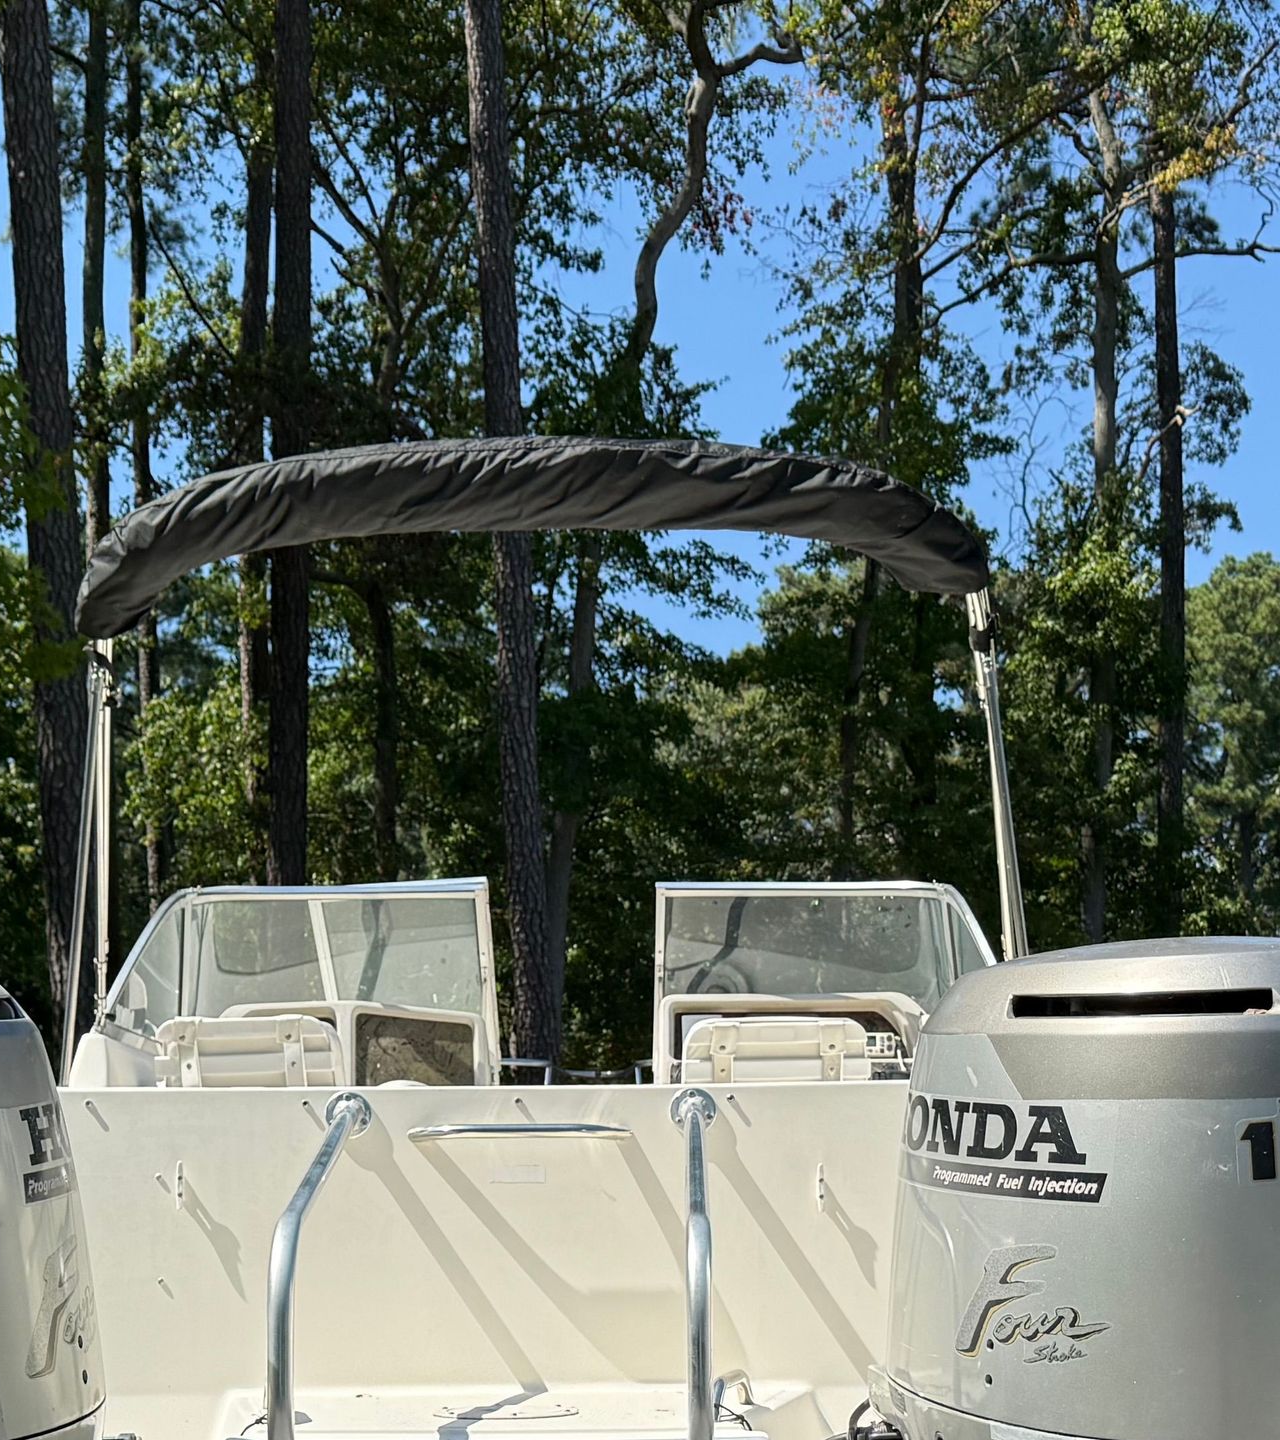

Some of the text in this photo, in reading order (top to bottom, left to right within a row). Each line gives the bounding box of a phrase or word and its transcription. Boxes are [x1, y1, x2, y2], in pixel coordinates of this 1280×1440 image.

[903, 1094, 1087, 1165] ONDA
[933, 1165, 1099, 1196] Programmed Fuel Injection
[955, 1243, 1112, 1358] Four
[1023, 1342, 1087, 1364] Stroke
